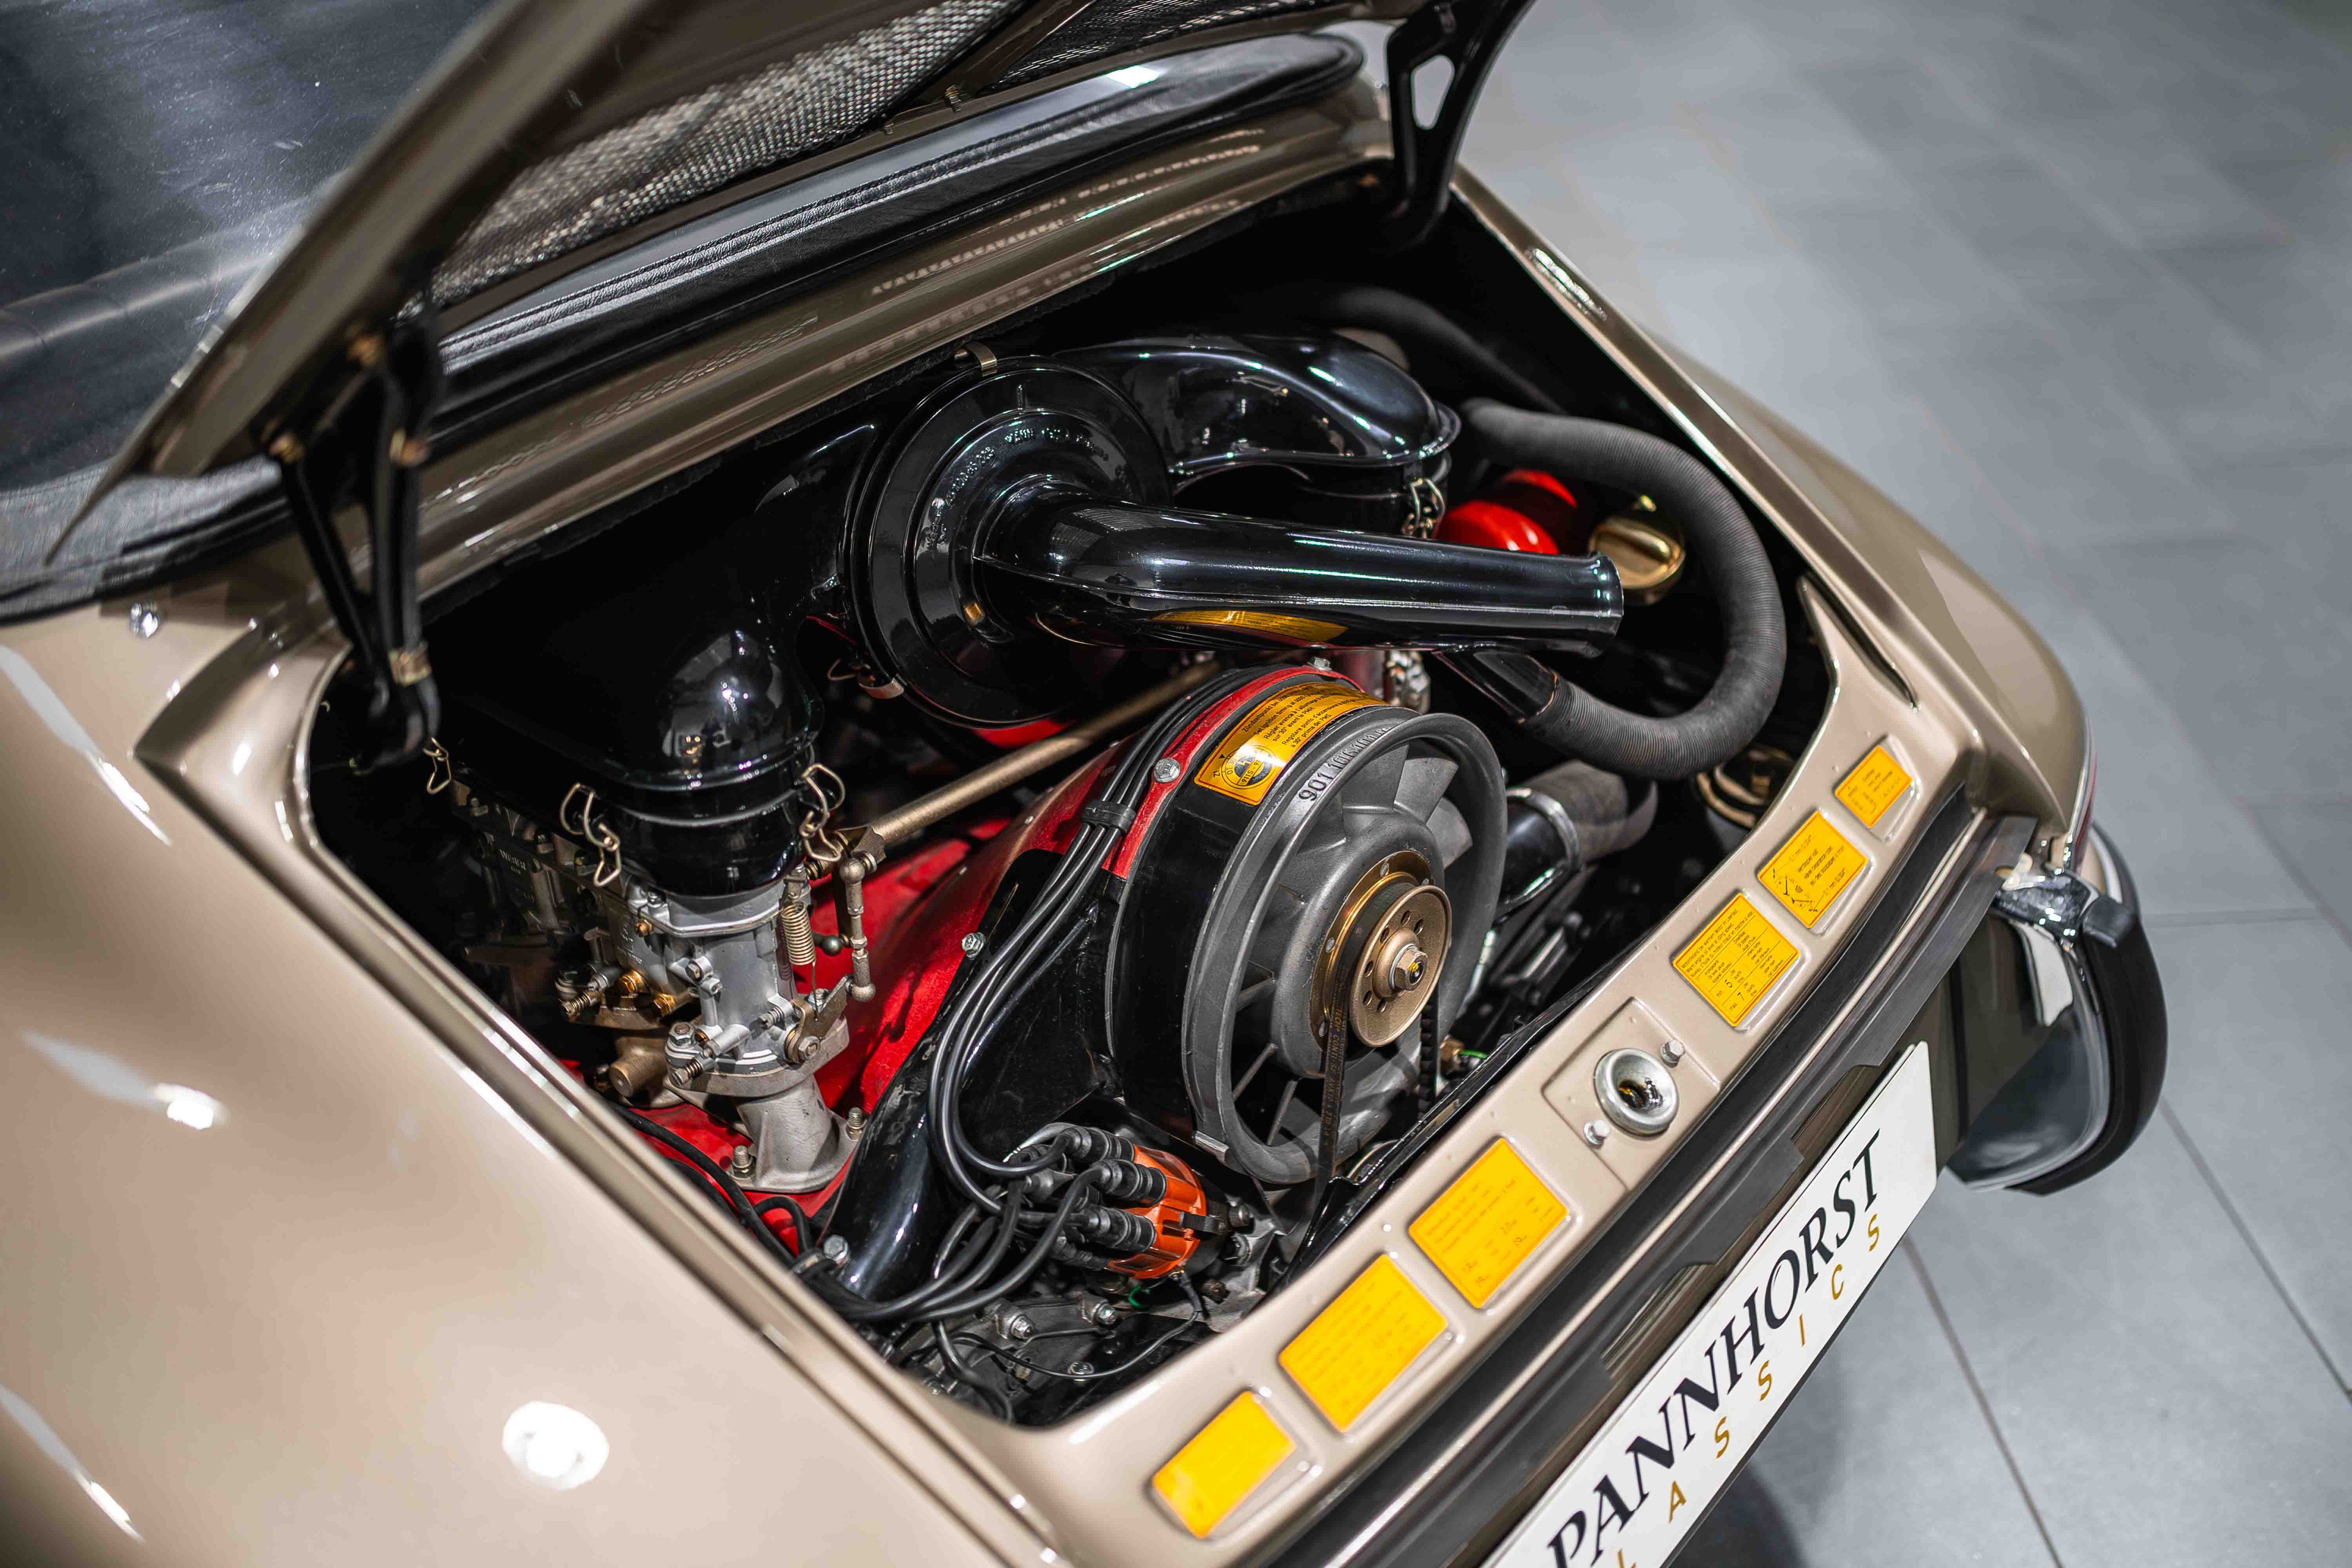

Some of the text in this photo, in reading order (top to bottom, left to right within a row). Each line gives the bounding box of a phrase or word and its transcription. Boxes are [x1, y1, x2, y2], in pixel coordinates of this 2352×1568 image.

[1261, 714, 1279, 728] ignition
[1276, 704, 1292, 715] timing
[1263, 725, 1280, 739] Régler
[1278, 713, 1294, 726] avance
[1287, 717, 1301, 727] avant
[1282, 728, 1303, 745] Regolare
[1301, 718, 1314, 728] punto
[1301, 726, 1315, 738] prima
[1298, 772, 1334, 801] 901
[1724, 979, 1733, 988] 5
[1737, 992, 1745, 1001] 7
[1547, 1128, 1881, 1568] PANNHORST
